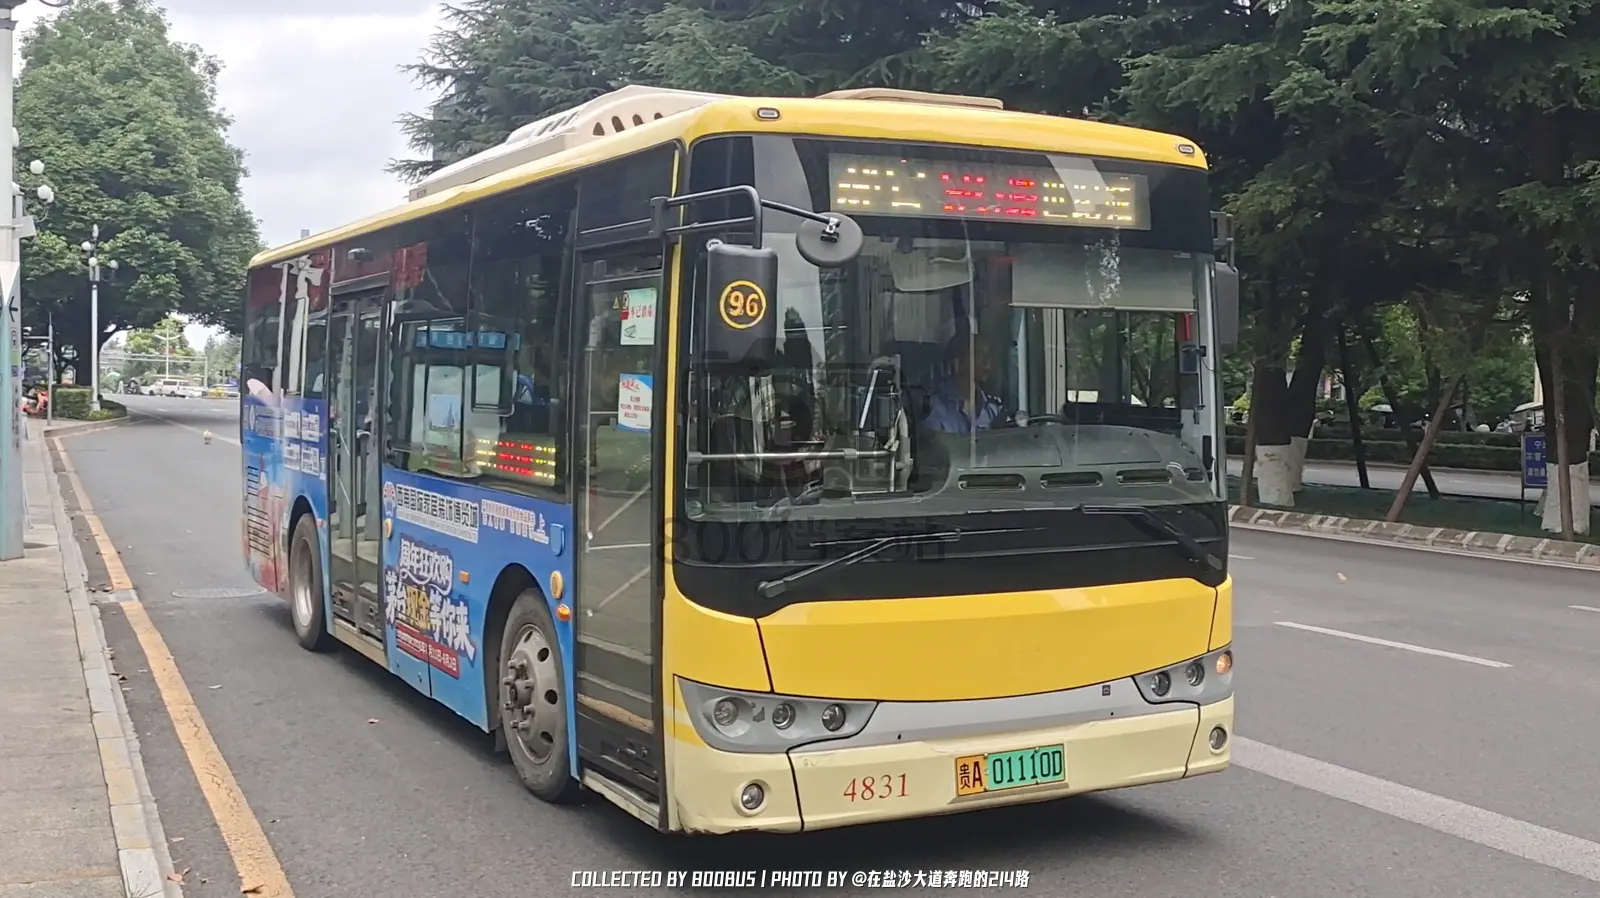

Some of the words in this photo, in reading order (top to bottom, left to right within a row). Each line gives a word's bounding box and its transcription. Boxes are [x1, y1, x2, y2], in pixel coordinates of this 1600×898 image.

[728, 290, 760, 318] 96
[400, 538, 452, 586] 周年狂欢购
[843, 773, 909, 802] 4831
